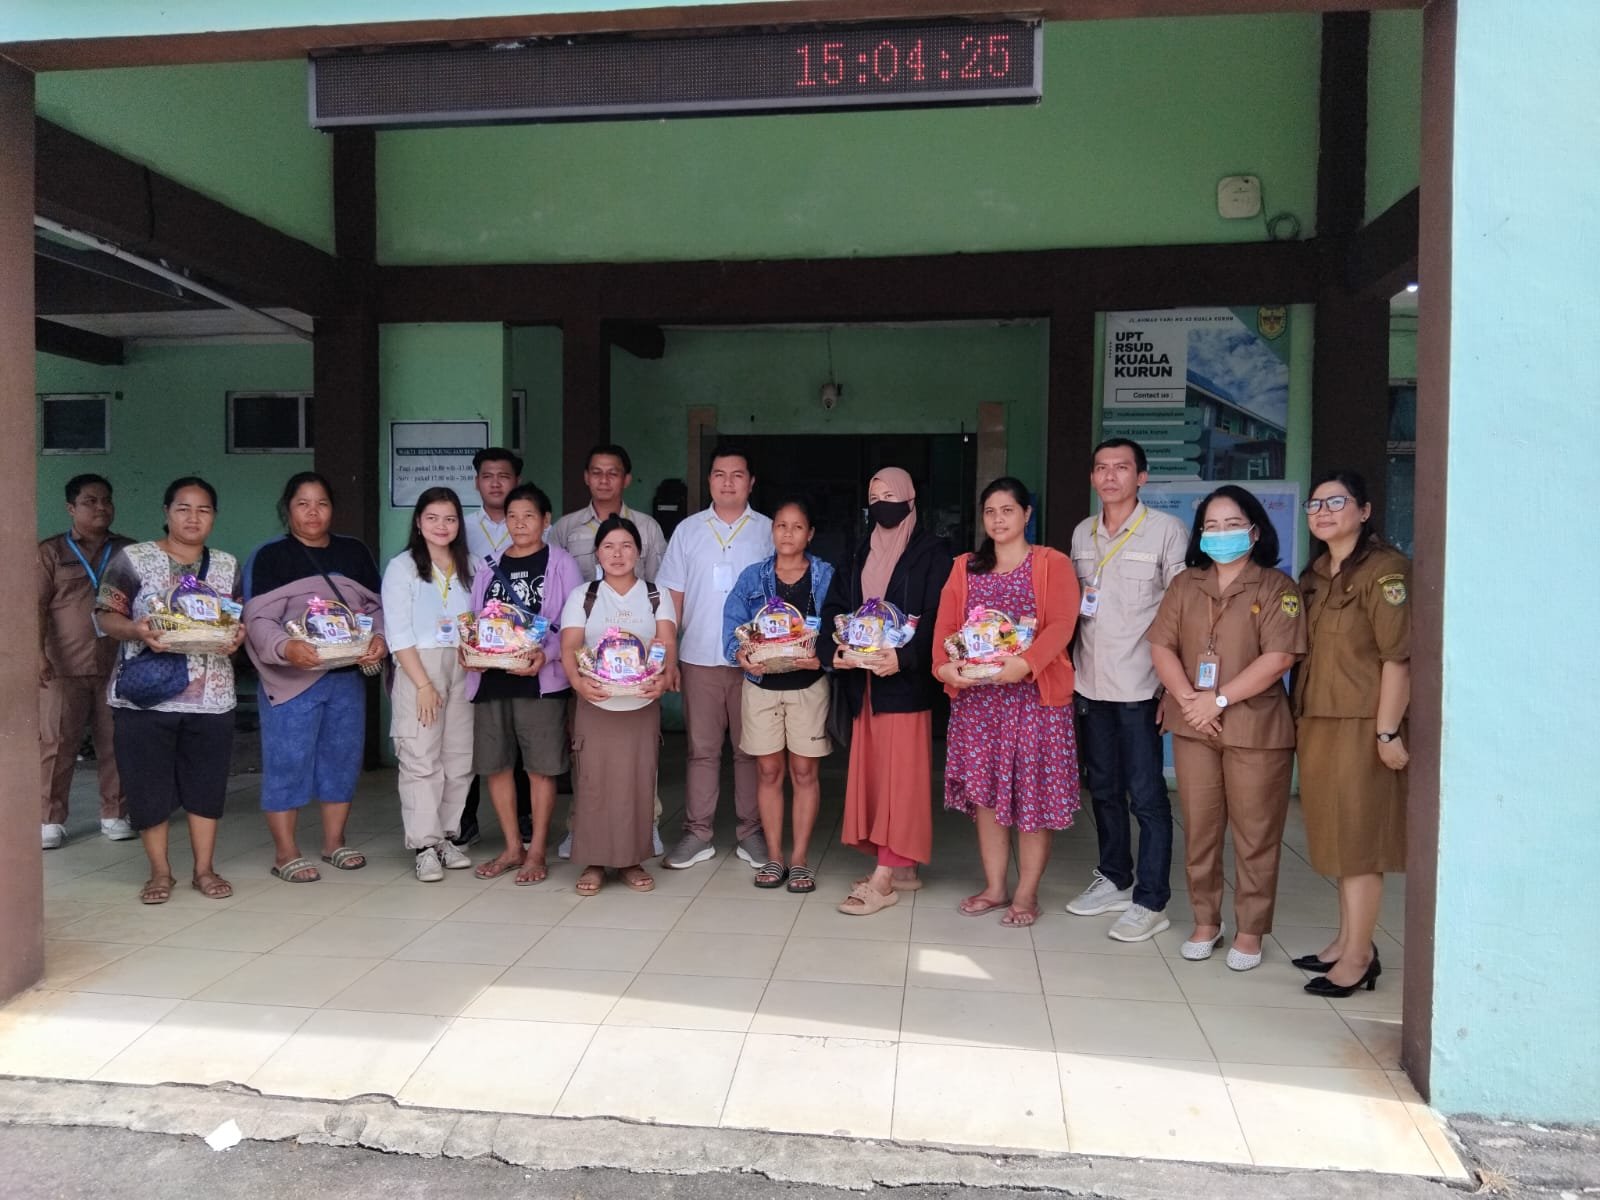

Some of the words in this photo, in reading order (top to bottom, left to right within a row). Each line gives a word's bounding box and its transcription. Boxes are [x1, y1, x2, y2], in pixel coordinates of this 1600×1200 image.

[796, 34, 1009, 86] 15:04:25
[1115, 332, 1144, 341] UPT
[1115, 343, 1153, 352] RSUD
[1115, 354, 1170, 365] KUALA
[1115, 366, 1172, 377] KURUN
